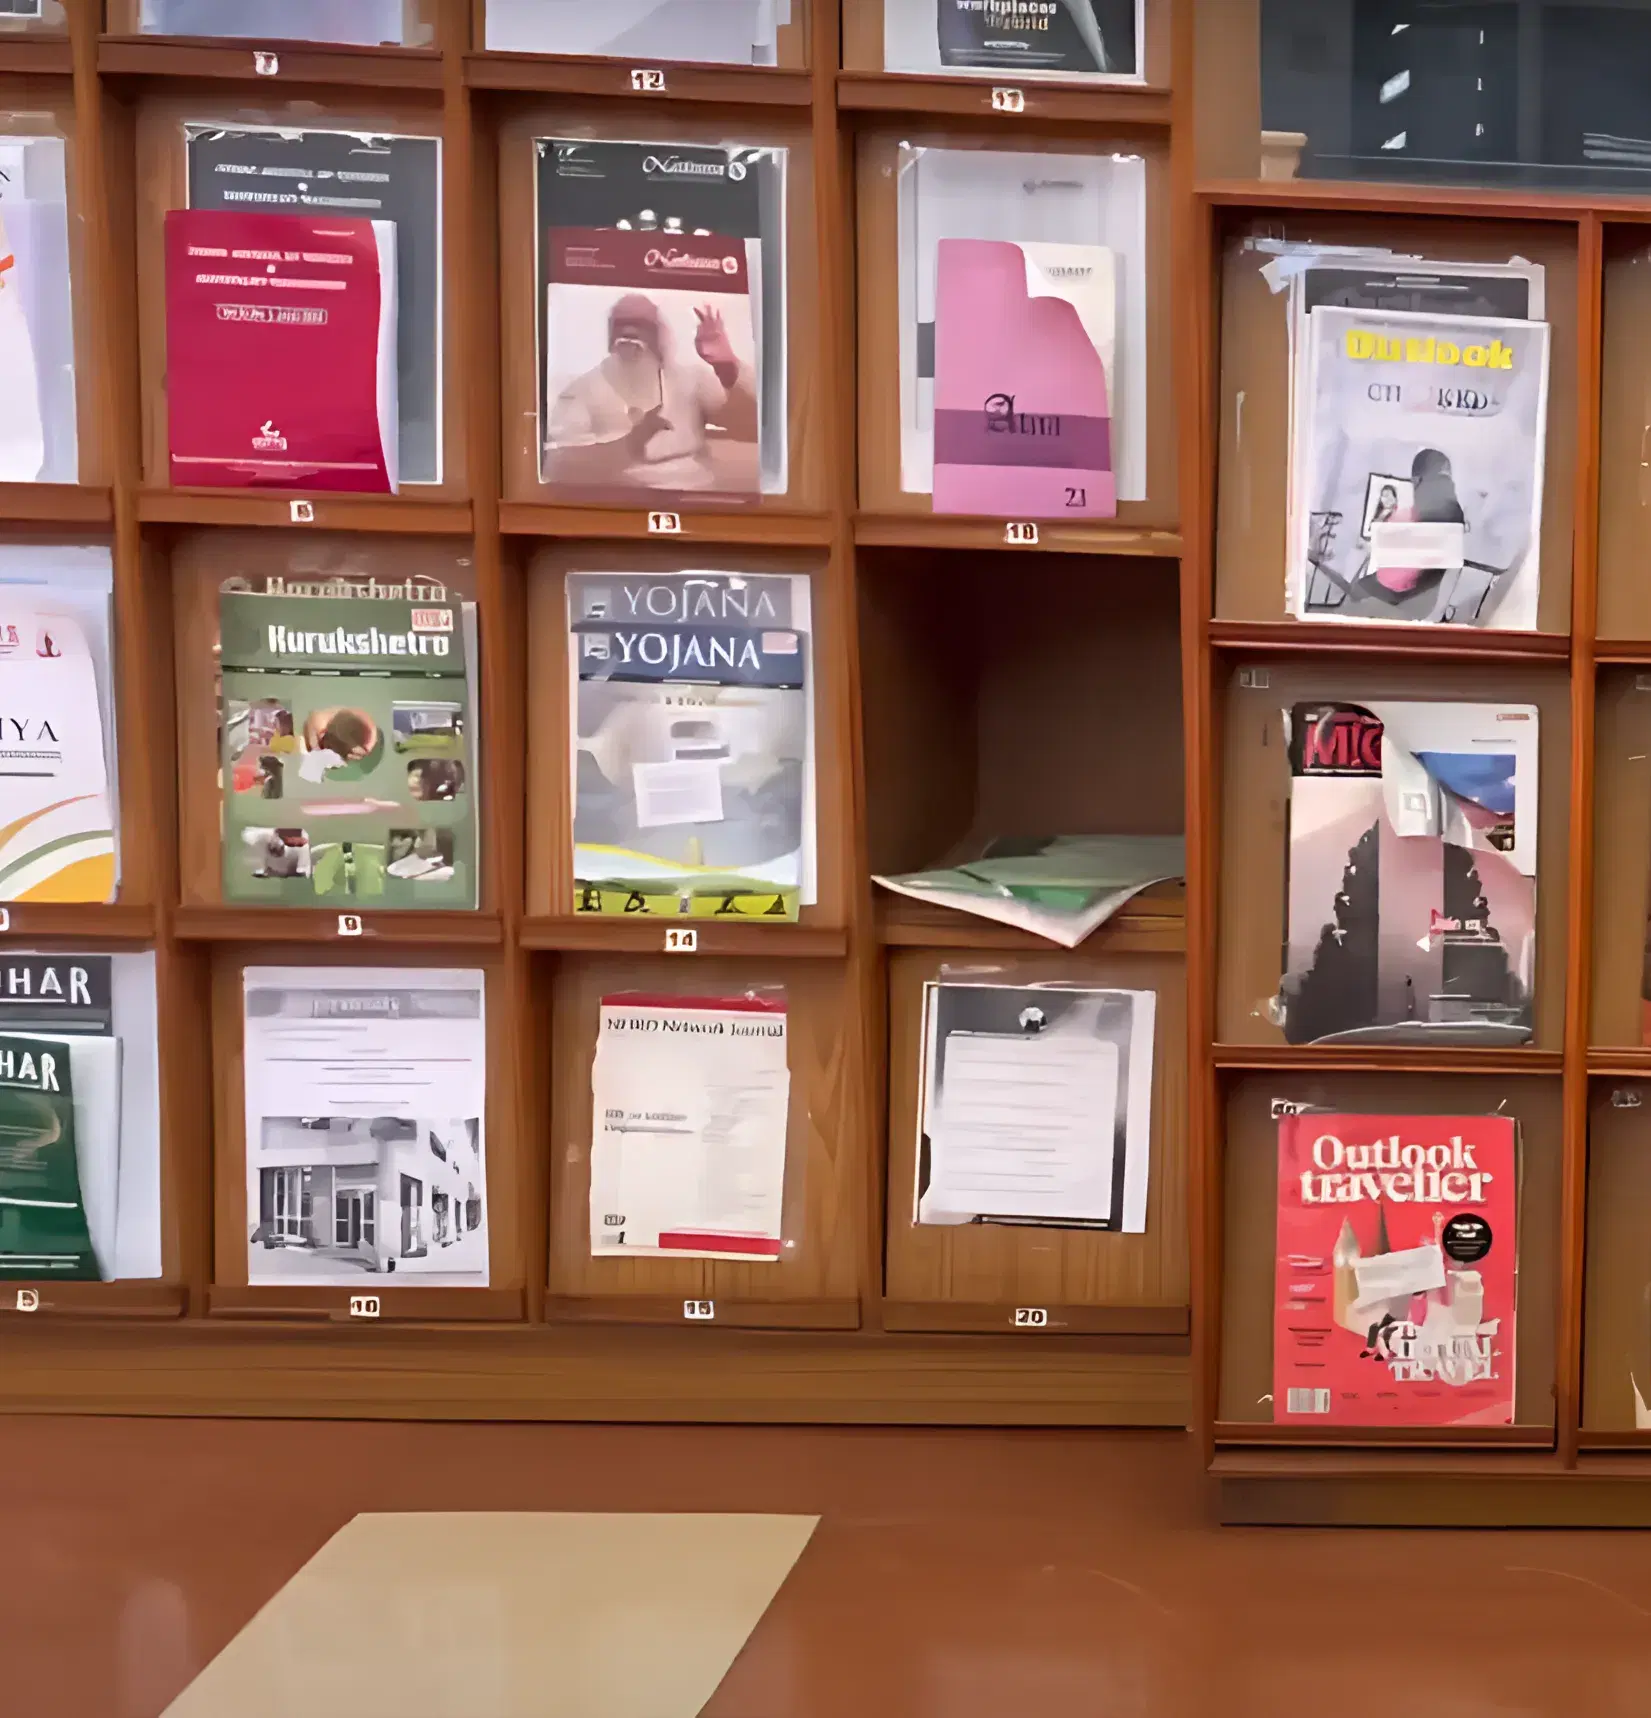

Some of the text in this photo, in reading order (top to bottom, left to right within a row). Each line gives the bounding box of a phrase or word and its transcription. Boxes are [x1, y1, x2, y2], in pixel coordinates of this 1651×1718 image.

[634, 72, 664, 88] 12
[1346, 329, 1513, 370] Outlook
[651, 513, 677, 530] 13
[614, 629, 762, 673] YOJANA
[0, 965, 92, 1005] HAR
[1312, 1134, 1479, 1171] Outlook
[1299, 1163, 1494, 1205] traveller
[1017, 1309, 1044, 1323] 20
